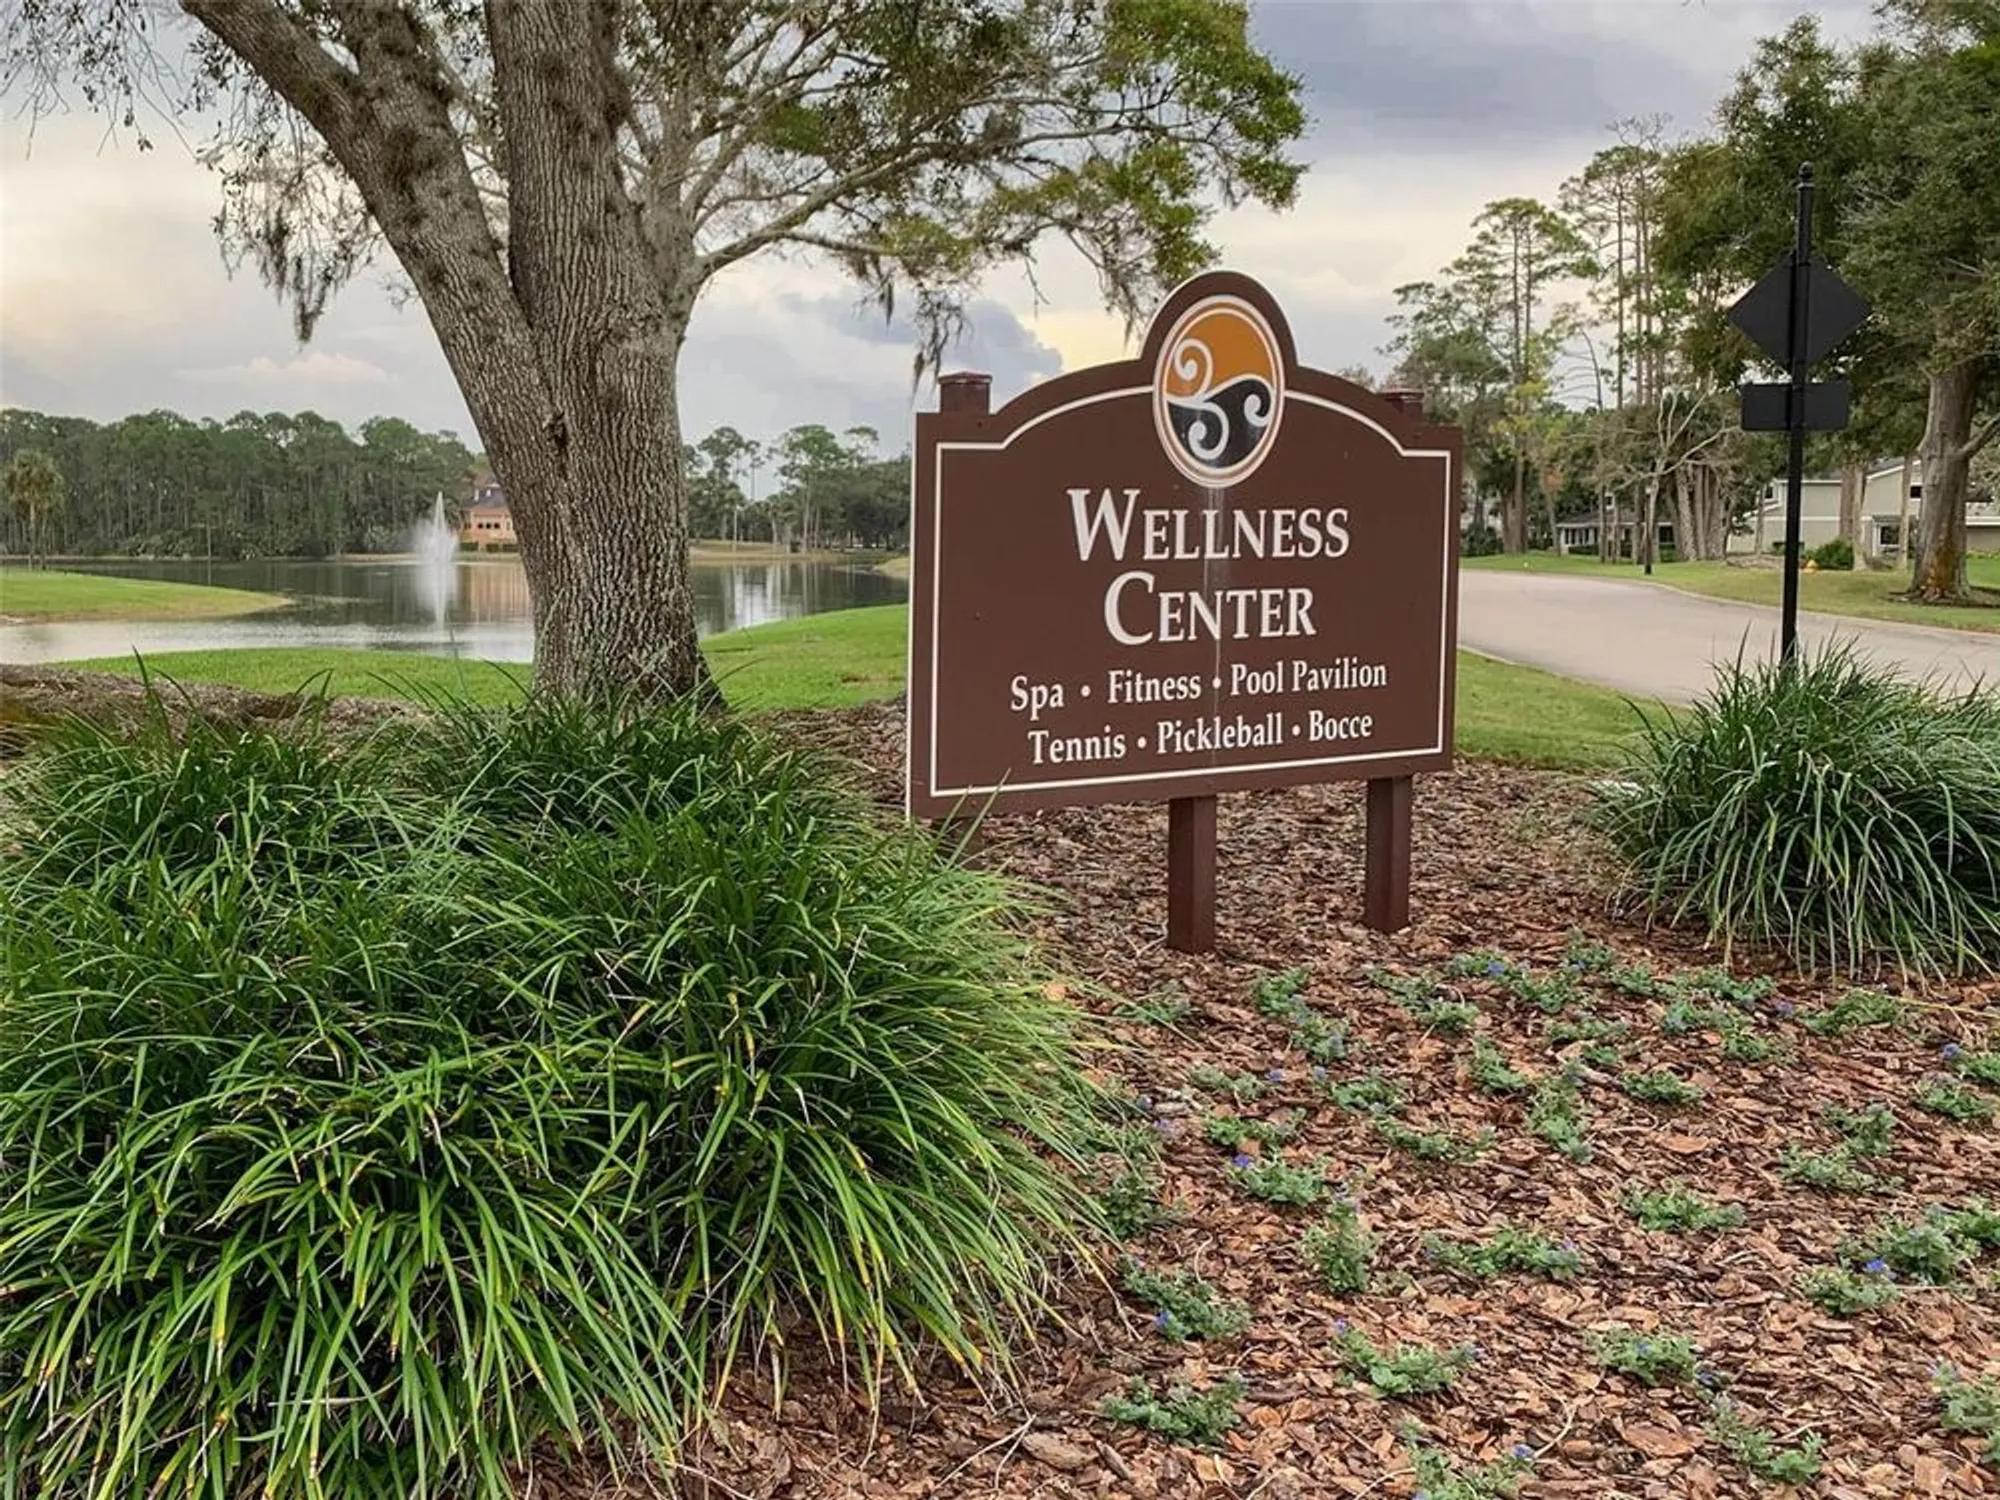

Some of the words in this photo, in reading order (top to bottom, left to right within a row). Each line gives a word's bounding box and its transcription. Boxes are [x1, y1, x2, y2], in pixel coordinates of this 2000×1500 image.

[1010, 675, 1065, 721] Spa
[1107, 669, 1202, 704] Fitness
[1230, 661, 1284, 696] Pool
[1291, 656, 1387, 692] Pavilion
[1027, 725, 1127, 764] Tennis
[1157, 712, 1284, 754] Pickleball
[1308, 709, 1373, 742] Bocce
